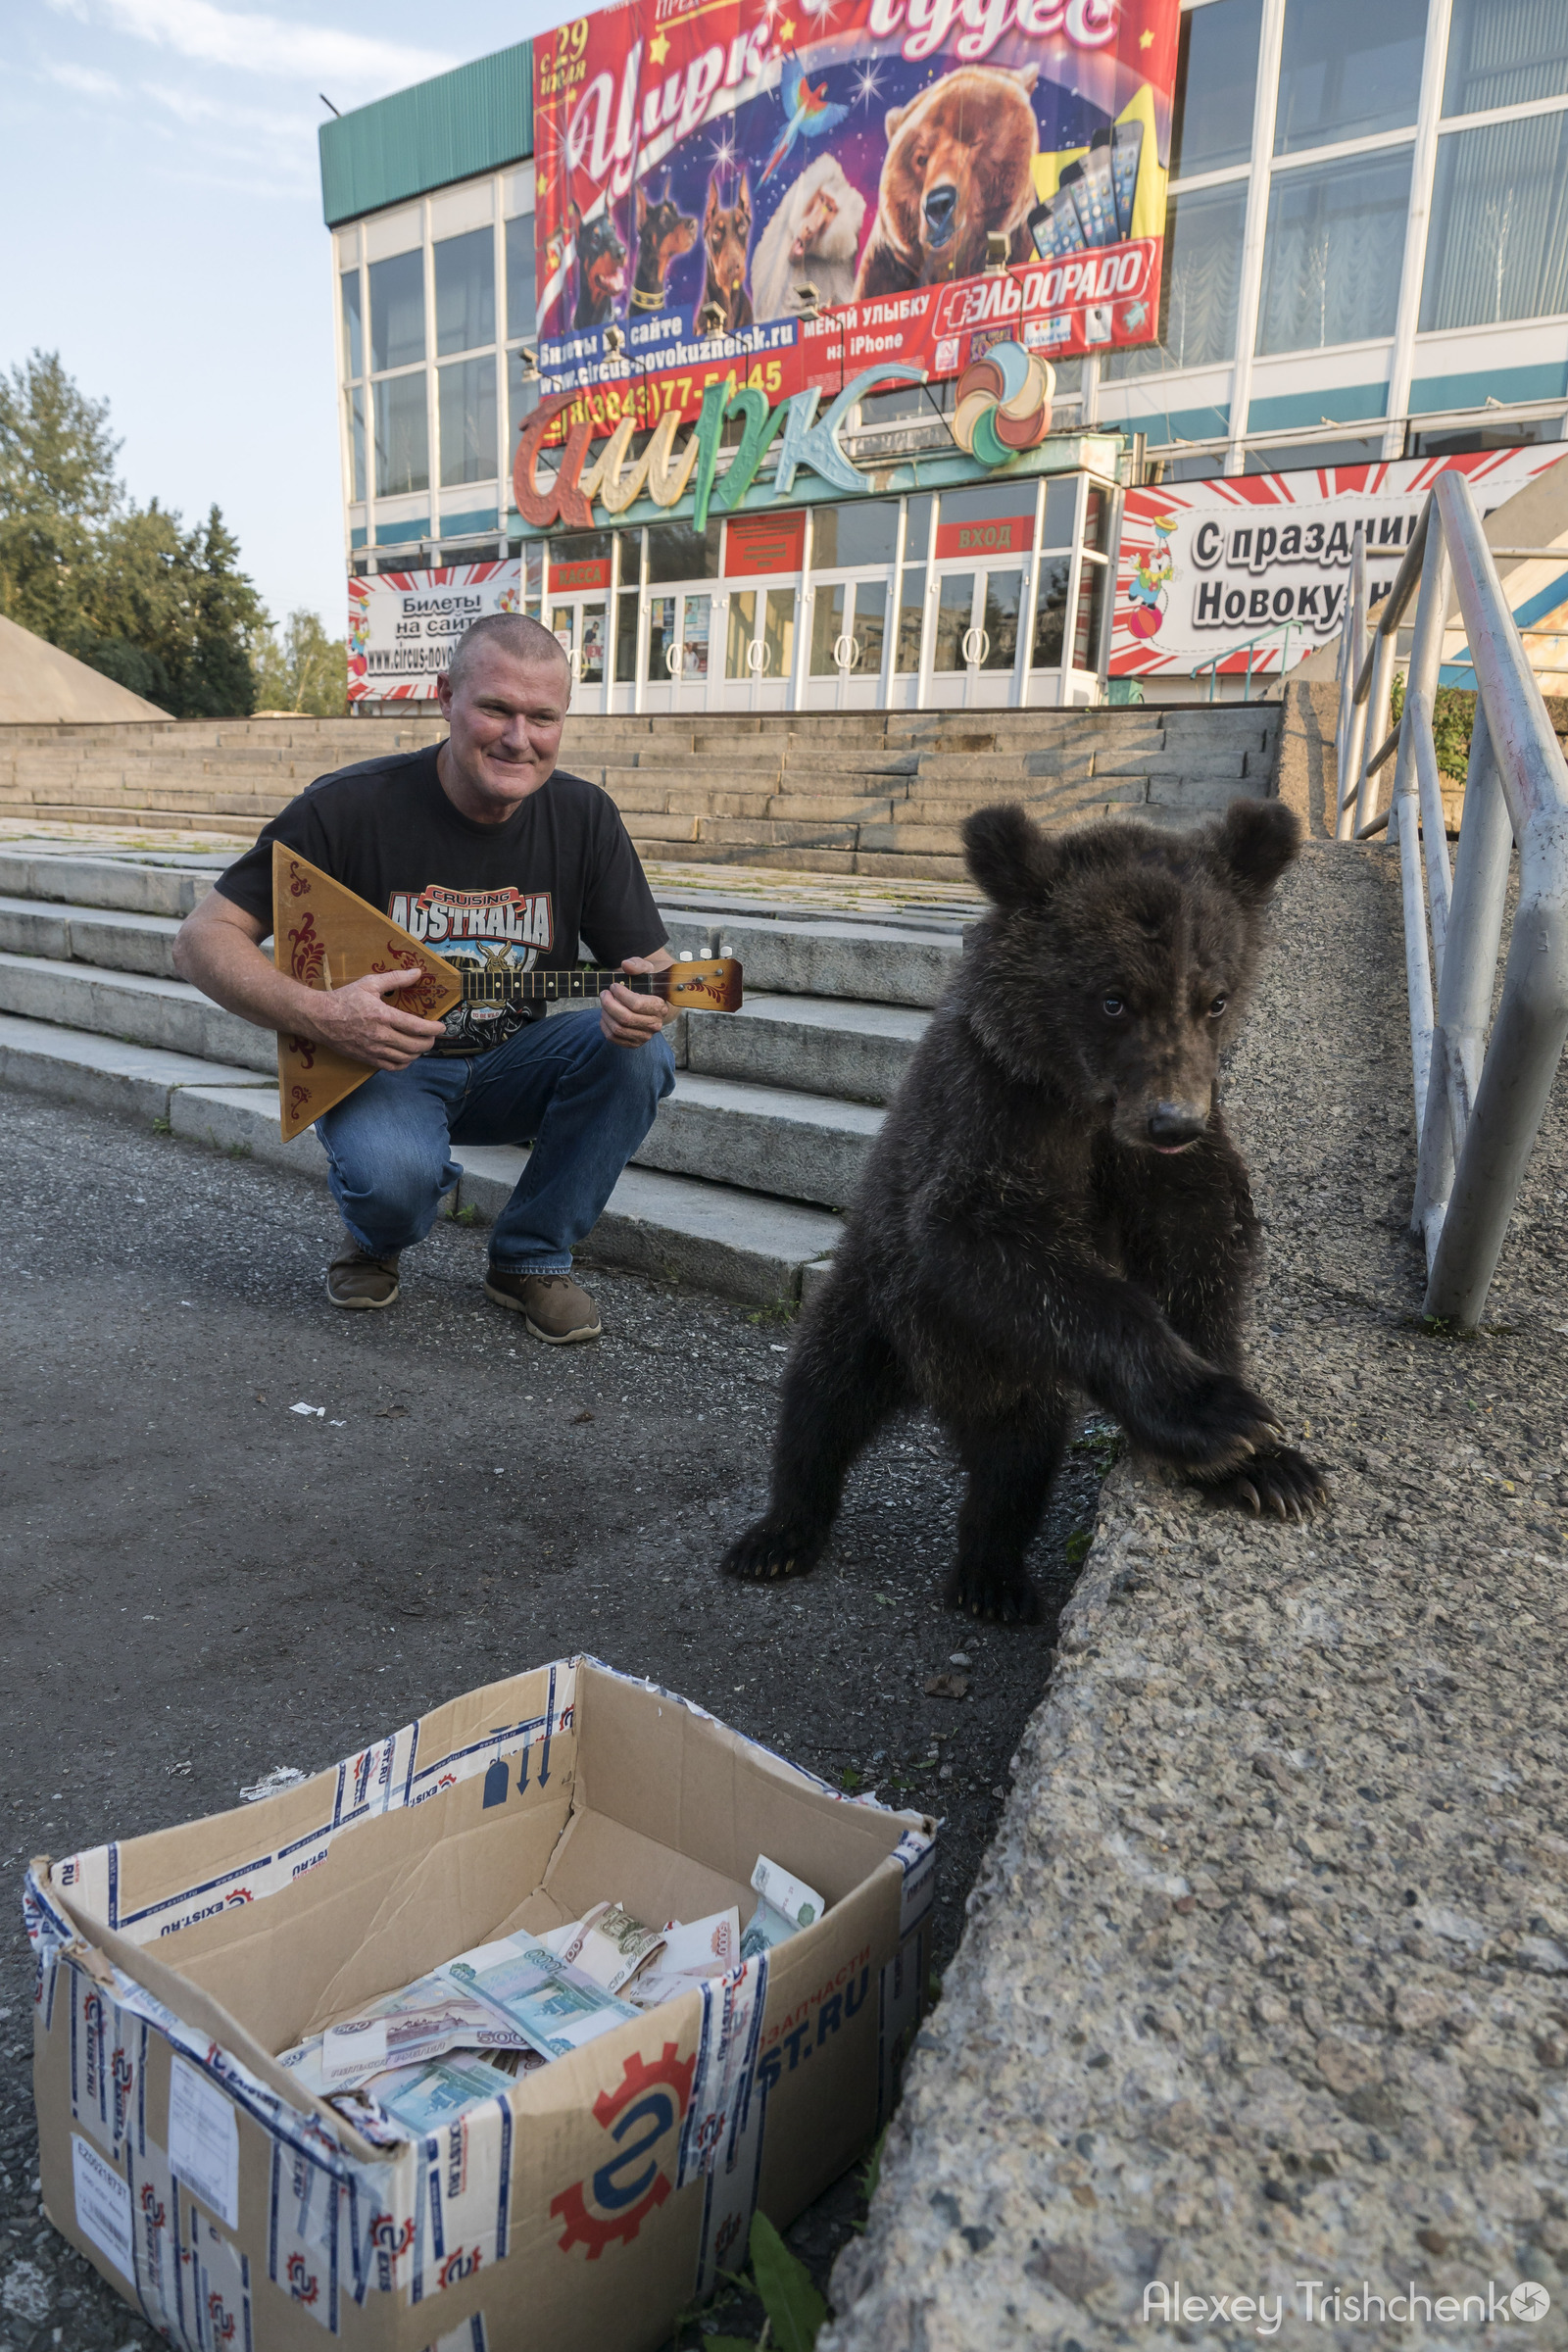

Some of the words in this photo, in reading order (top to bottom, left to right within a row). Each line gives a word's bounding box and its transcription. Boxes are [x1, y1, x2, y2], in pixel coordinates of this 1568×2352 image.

[556, 16, 589, 71] 29
[565, 22, 772, 199] Цирк
[804, 306, 858, 338] МЕНЯЙ
[862, 294, 930, 327] УЛЫБКУ
[630, 316, 683, 346] сайте
[826, 344, 846, 361] на
[851, 333, 904, 356] iPhone
[957, 524, 1012, 550] ВХОД
[1196, 521, 1222, 563] С
[1231, 514, 1422, 568] праздни
[559, 565, 602, 586] КАССА
[403, 595, 481, 614] Билеты
[397, 621, 419, 635] на
[368, 640, 457, 672] www.circus-novo
[432, 890, 511, 906] CRUISING
[391, 896, 551, 948] AUSTRALIA
[161, 1900, 224, 1937] EXIST.RU
[717, 1924, 729, 1956] 5000
[524, 1948, 568, 1975] 1000
[335, 2019, 371, 2034] 500
[476, 2030, 527, 2046] 500
